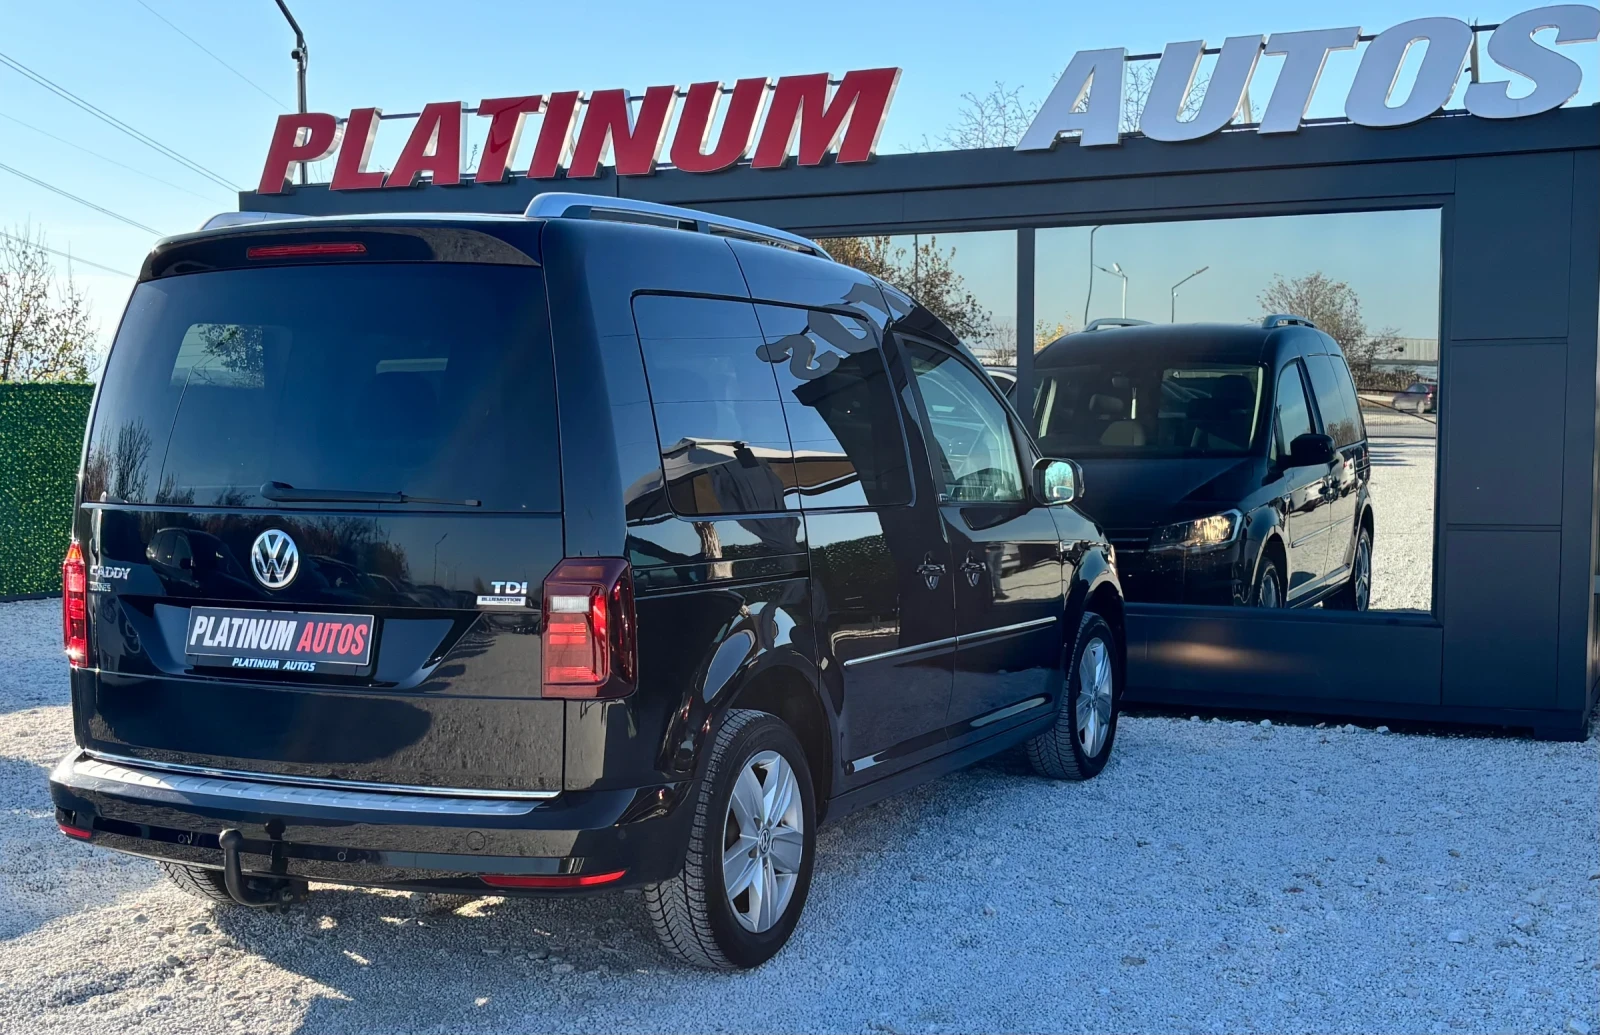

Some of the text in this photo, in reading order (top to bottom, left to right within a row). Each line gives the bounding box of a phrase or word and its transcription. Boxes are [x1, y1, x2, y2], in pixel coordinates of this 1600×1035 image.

[256, 4, 1600, 194] PLATINUM AUTOS
[90, 565, 131, 580] CADDY
[491, 581, 528, 594] TDI
[190, 615, 367, 655] PLATINUM AUTOS
[232, 658, 316, 672] PLATINUM AUTOS
